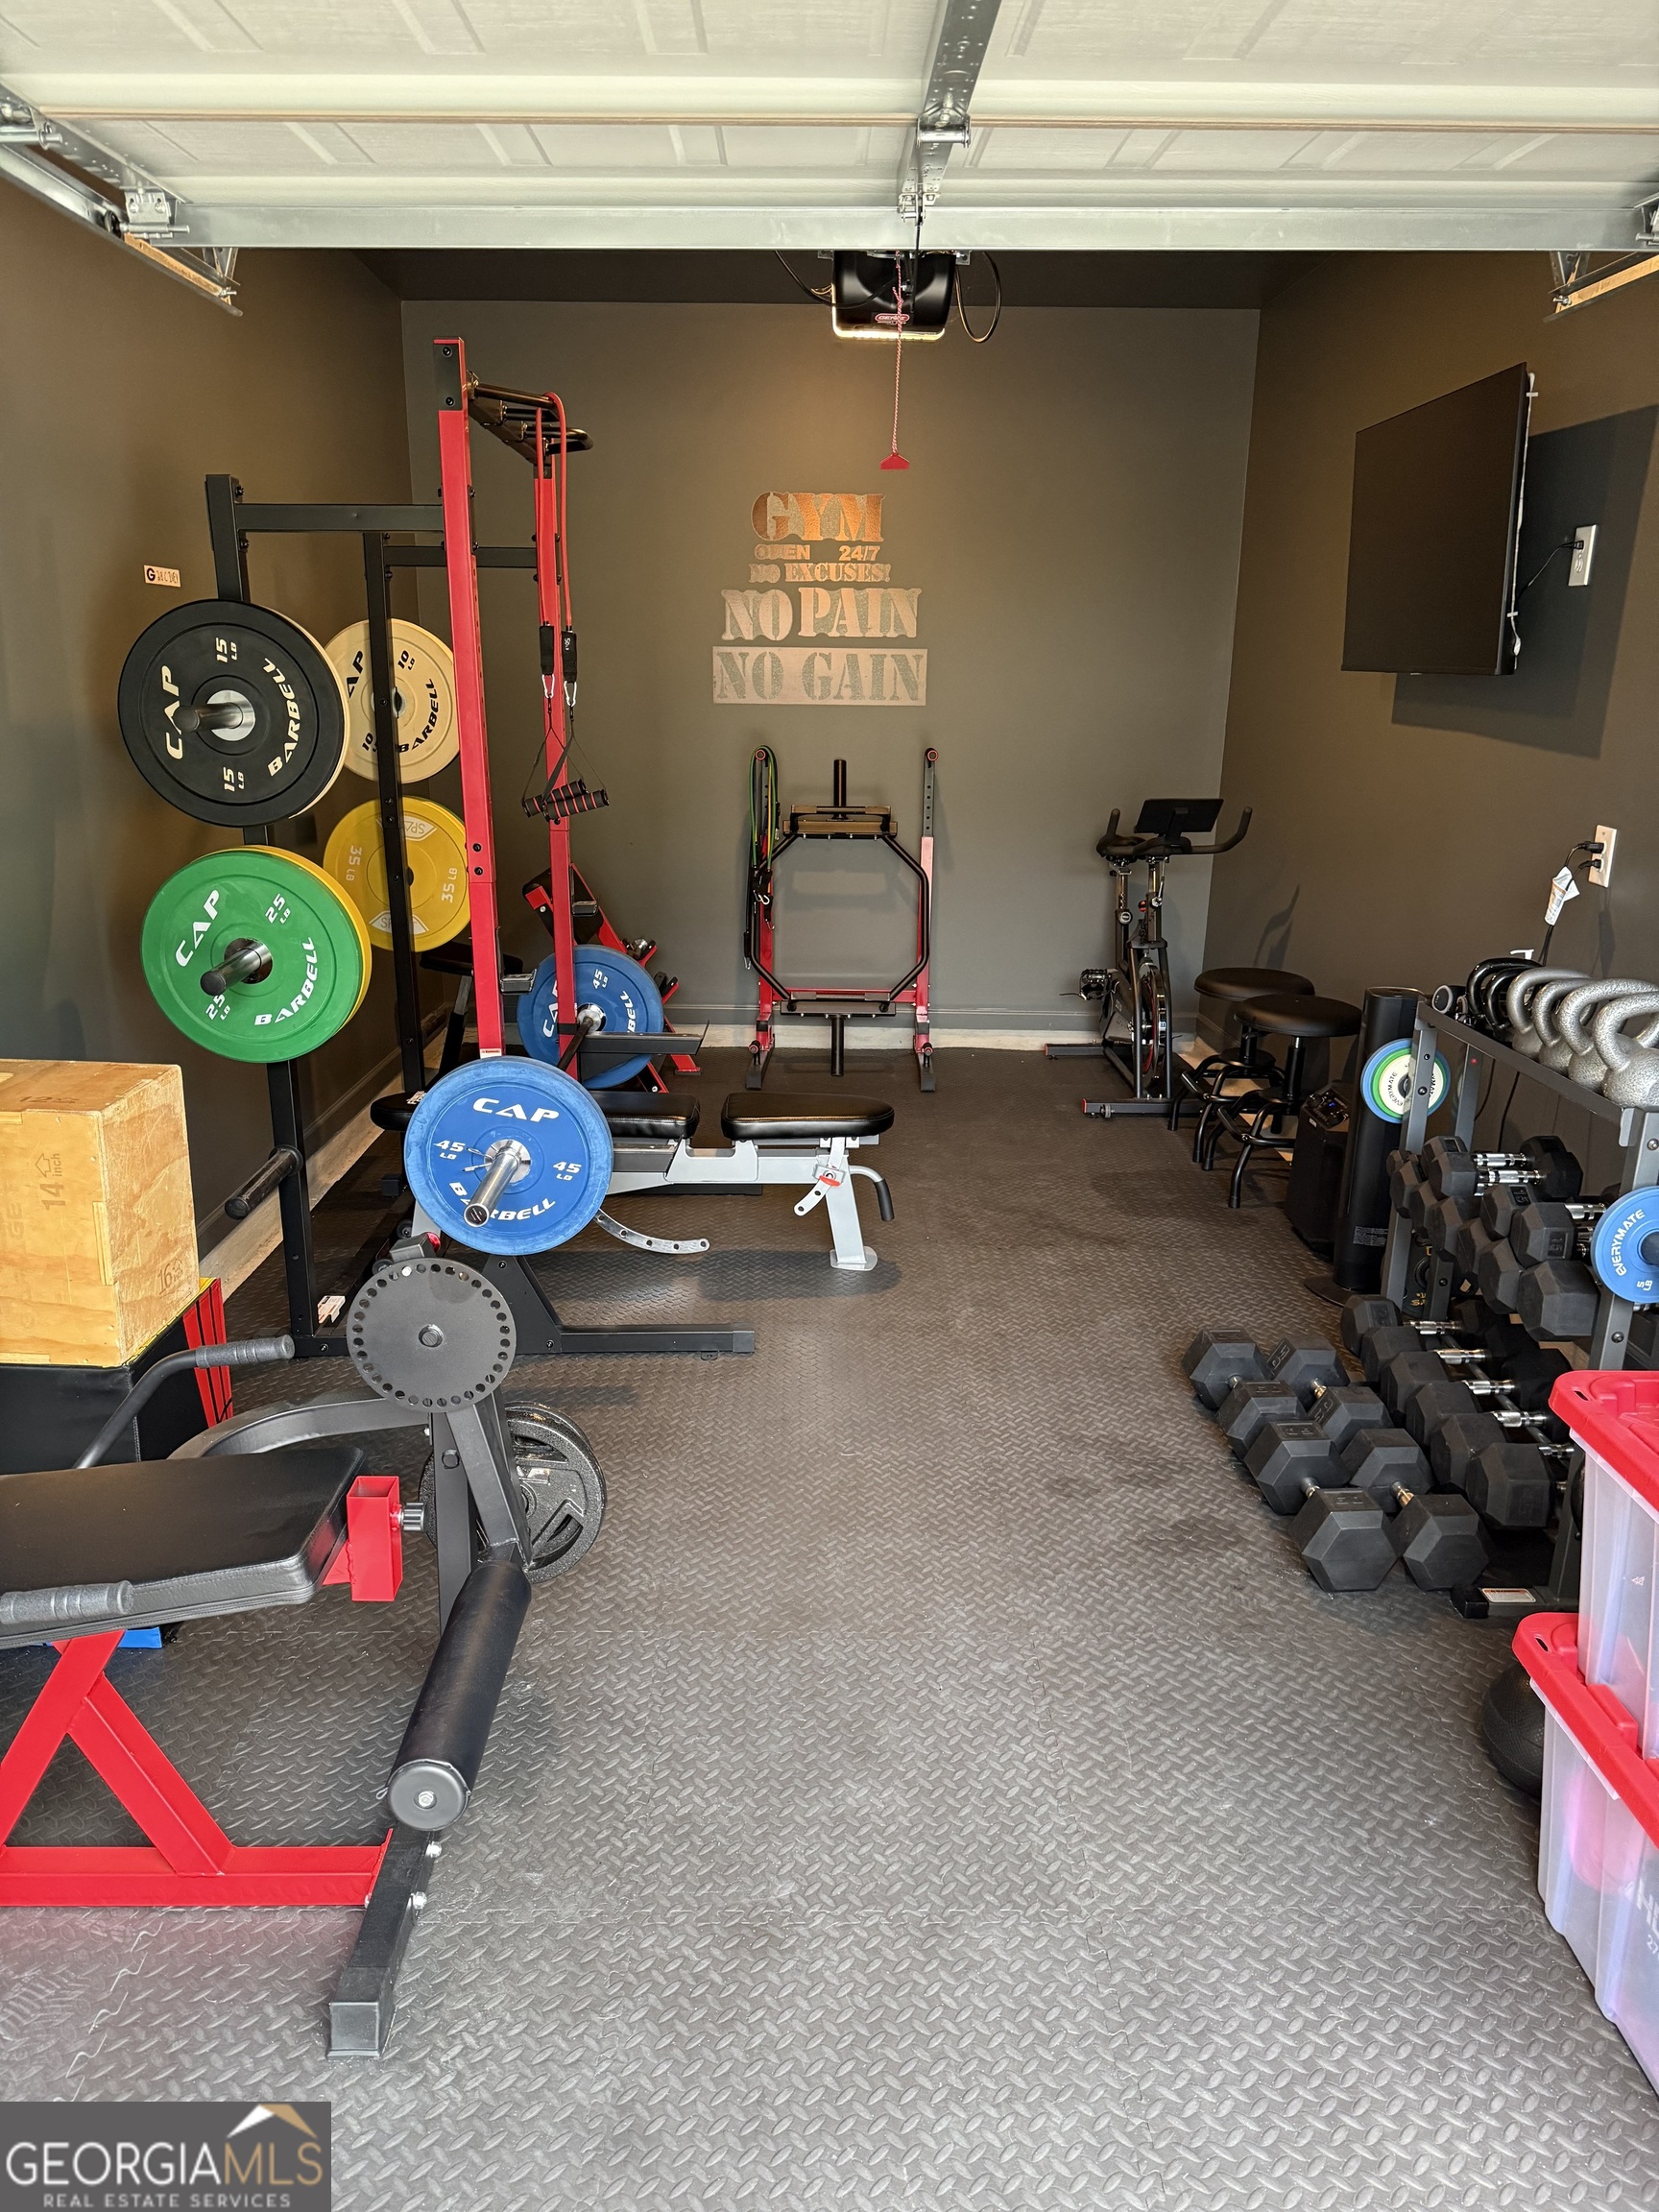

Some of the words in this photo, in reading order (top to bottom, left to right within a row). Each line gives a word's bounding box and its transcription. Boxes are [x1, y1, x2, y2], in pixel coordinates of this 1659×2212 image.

[751, 491, 885, 541] GYM
[754, 543, 810, 560] OPEN
[838, 544, 880, 561] 24/7
[748, 563, 781, 584] NO
[784, 562, 892, 583] EXCUSES!
[721, 589, 793, 641] NO
[798, 587, 922, 638] PAIN
[215, 637, 228, 663] 15
[230, 641, 238, 661] LB
[397, 650, 409, 670] 10
[346, 650, 364, 699] AP
[717, 651, 784, 700] NO
[802, 652, 924, 701] GAIN
[160, 664, 184, 760] CAP
[262, 658, 301, 777] BARBELL
[398, 678, 439, 754] BARBELL
[361, 732, 373, 752] 10
[222, 767, 235, 792] 15
[237, 772, 245, 790] LB
[348, 845, 363, 866] 35
[441, 882, 455, 903] 35
[448, 867, 458, 880] LB
[265, 893, 286, 924] 25
[279, 907, 291, 925] LB
[175, 889, 220, 967] CAP
[254, 937, 319, 1026] BARBELL
[592, 969, 603, 990] 45
[204, 993, 227, 1021] 25
[219, 1004, 231, 1021] LB
[472, 1097, 560, 1122] CAP
[434, 1140, 466, 1152] 45
[439, 1151, 457, 1160] LB
[52, 1152, 62, 1177] inch
[552, 1161, 582, 1175] 45
[40, 1181, 66, 1211] 14
[1611, 1209, 1645, 1276] EVERYMATE
